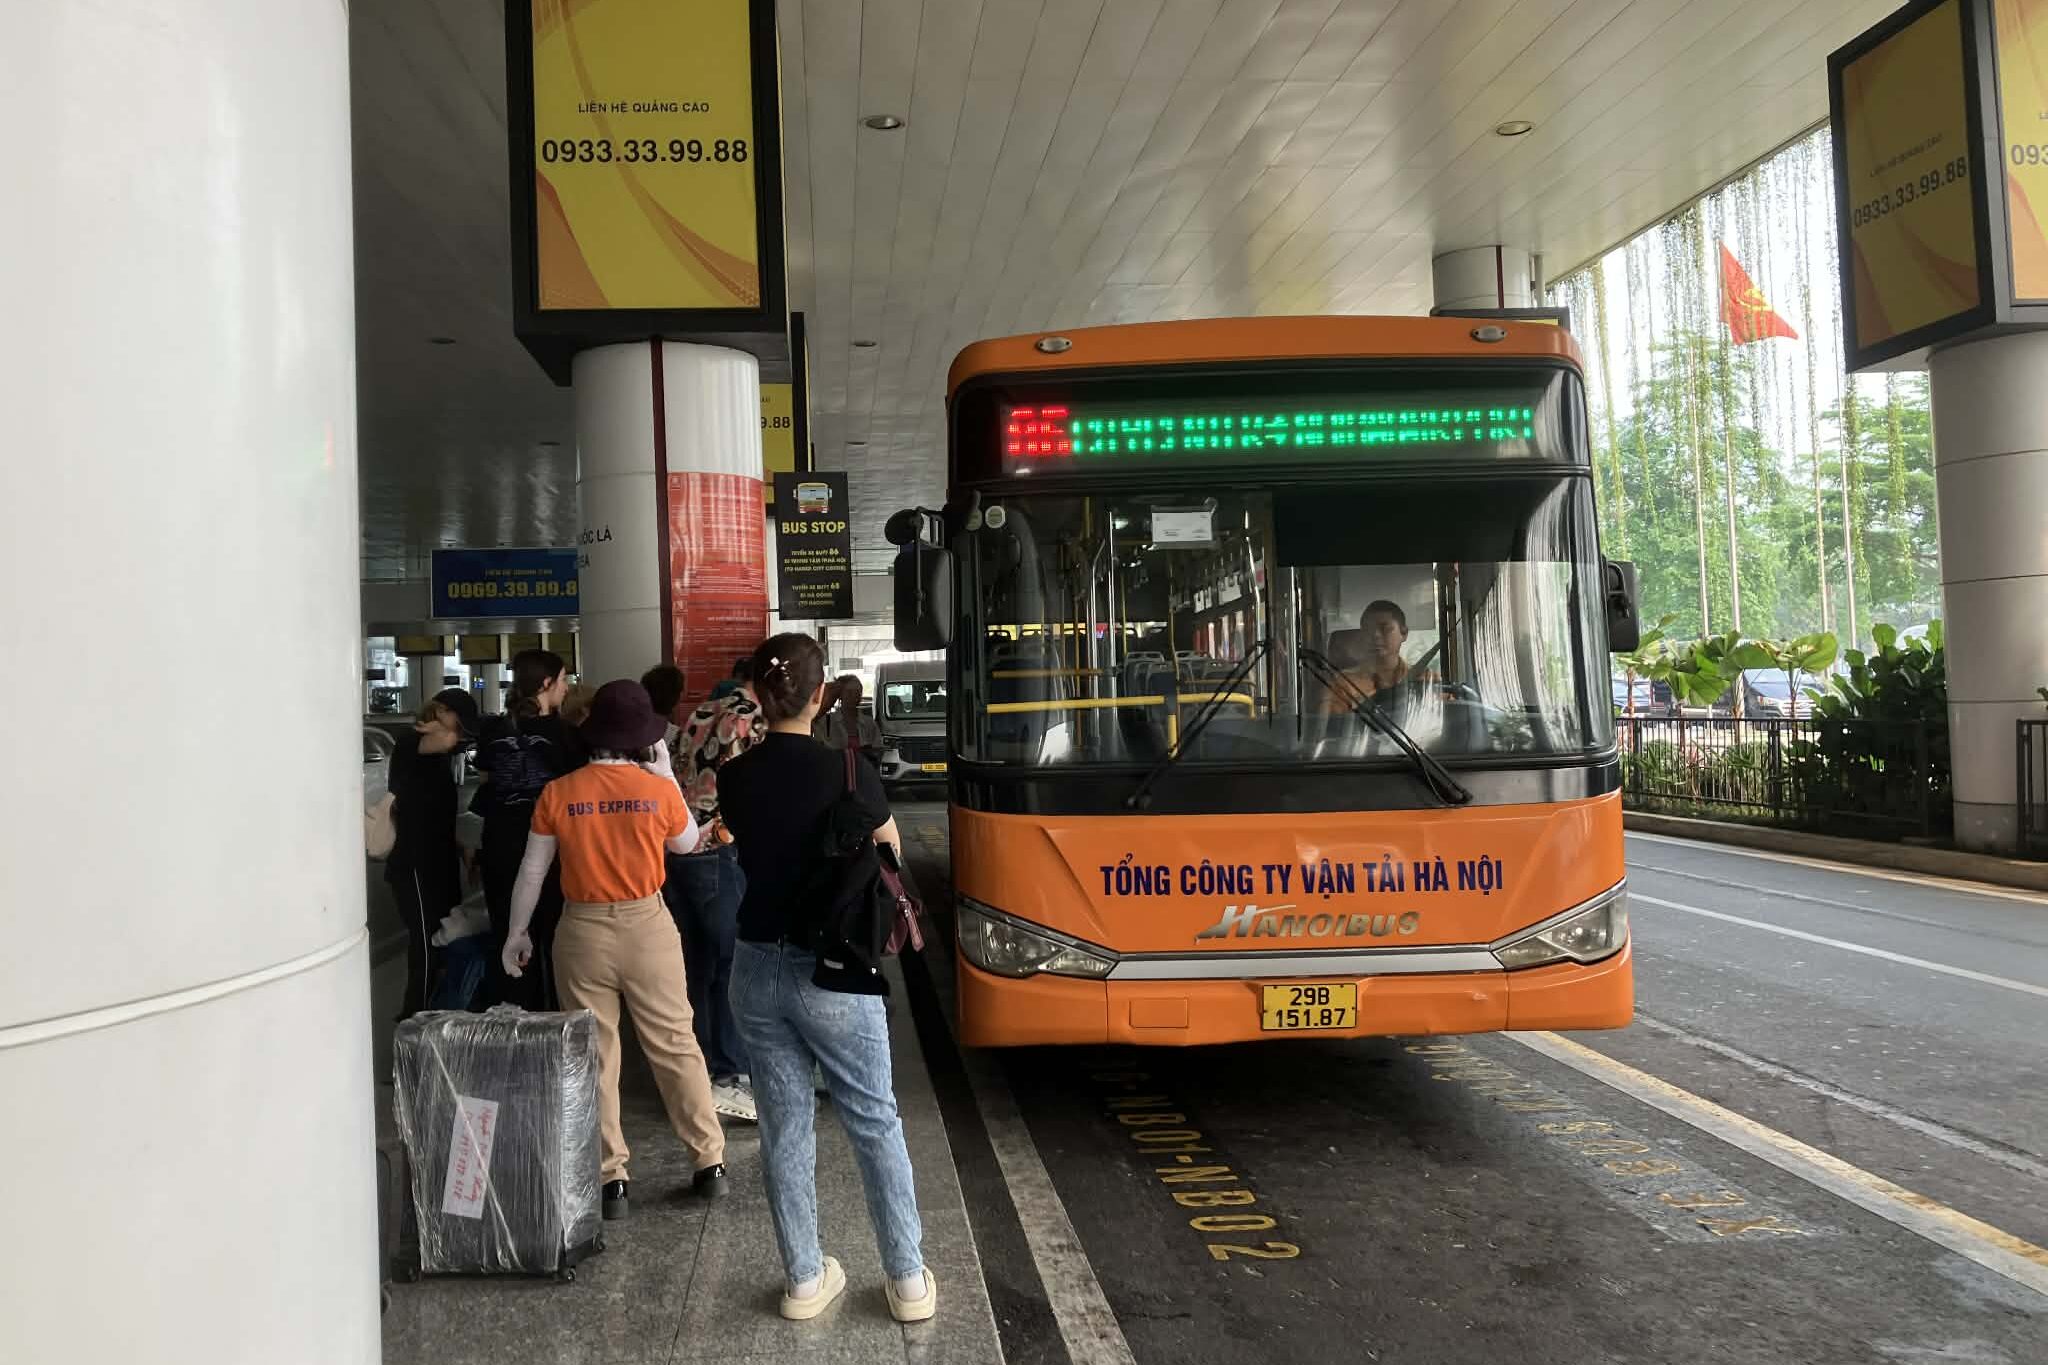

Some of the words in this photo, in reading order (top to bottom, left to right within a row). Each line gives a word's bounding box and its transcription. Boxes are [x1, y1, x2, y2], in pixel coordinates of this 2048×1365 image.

[541, 139, 748, 163] 0933.33.99.88
[1854, 156, 1967, 228] 0933.33.99.88
[782, 521, 808, 534] BUS
[811, 521, 846, 533] STOP
[567, 803, 595, 817] BUS
[1100, 853, 1171, 896] TỔNG
[1180, 859, 1254, 896] CÔNG
[1261, 865, 1293, 895] TY
[1301, 858, 1356, 900] VẬN
[1362, 853, 1406, 893] TẢI
[1413, 855, 1450, 892] HÀ
[1457, 854, 1504, 896] NỘI
[1194, 904, 1421, 945] HANOIBUS
[1290, 986, 1331, 1006] 29B
[1275, 1008, 1347, 1028] 151.87
